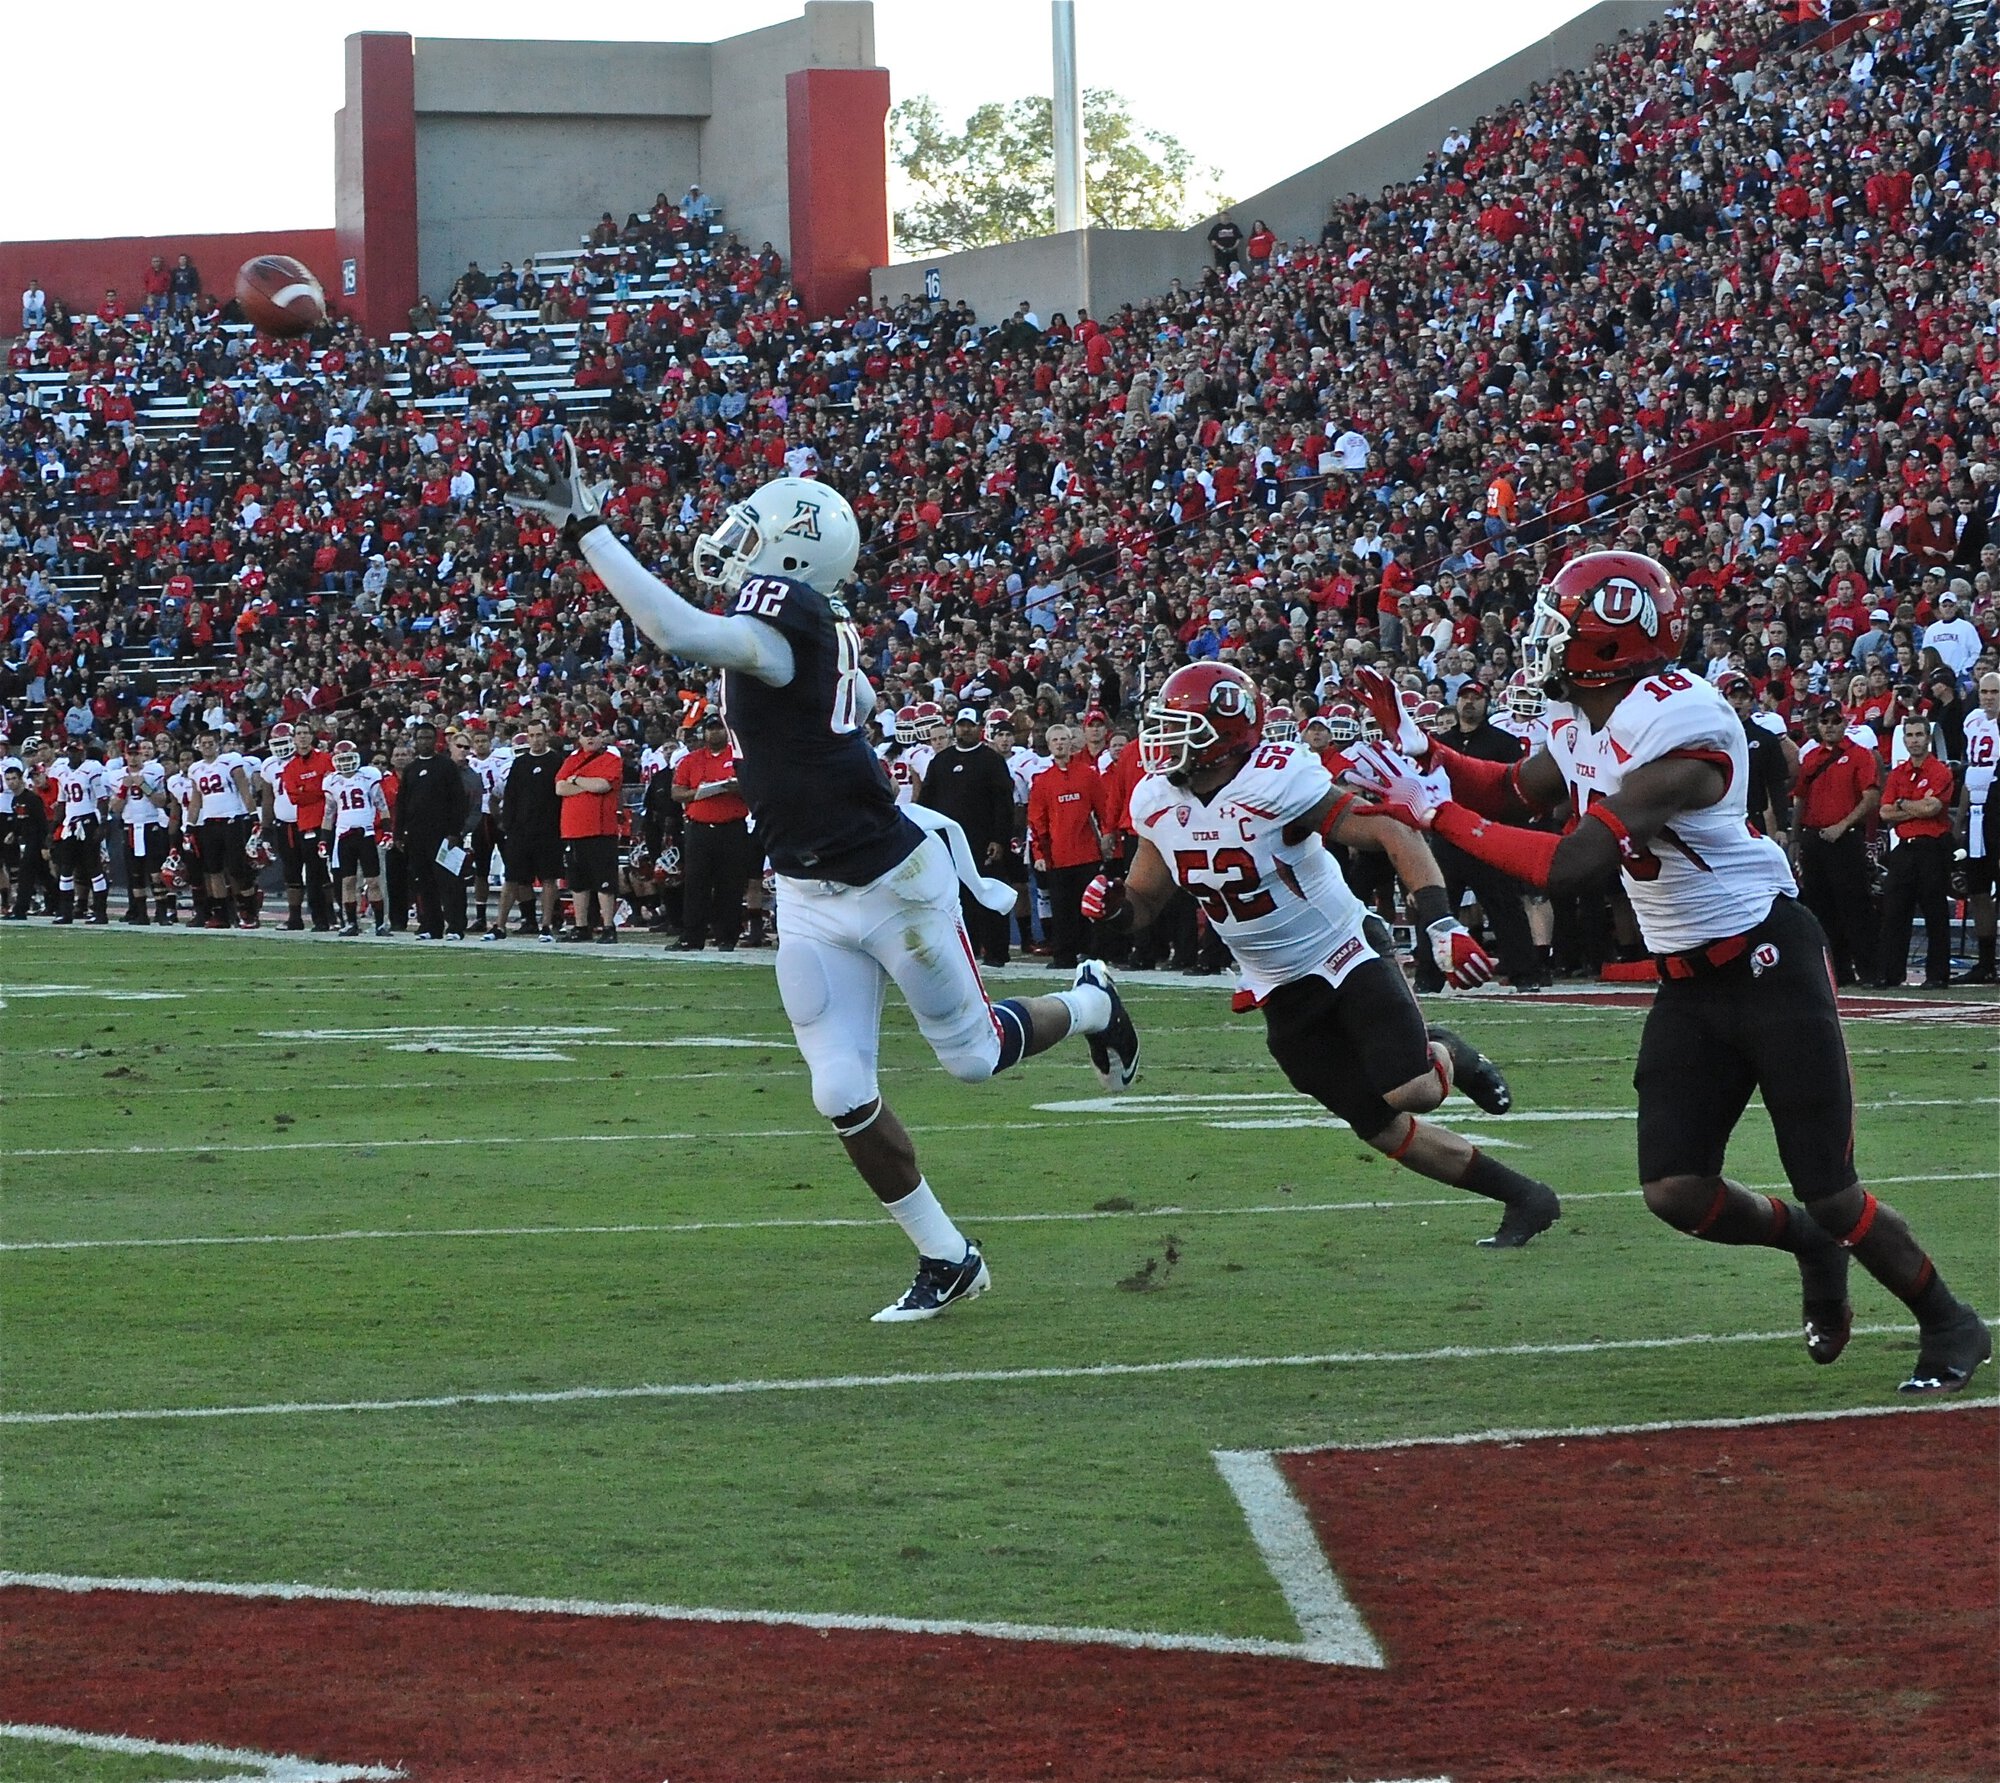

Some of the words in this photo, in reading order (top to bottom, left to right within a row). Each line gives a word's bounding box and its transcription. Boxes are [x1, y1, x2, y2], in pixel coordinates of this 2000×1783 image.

[343, 264, 356, 290] 15
[926, 273, 941, 298] 16
[784, 499, 822, 542] A
[735, 579, 789, 617] 82
[1602, 585, 1637, 620] U
[1216, 686, 1240, 713] U
[1644, 672, 1693, 702] 18
[1254, 744, 1295, 770] 52
[1970, 735, 1994, 768] 12
[1576, 762, 1597, 779] UTAH
[64, 783, 84, 803] 10
[199, 774, 225, 796] 82
[1058, 792, 1080, 804] UTAH
[339, 788, 366, 811] 16
[1192, 831, 1220, 842] UTAH
[1238, 816, 1256, 843] C
[1173, 847, 1278, 924] 52
[1756, 946, 1775, 966] U
